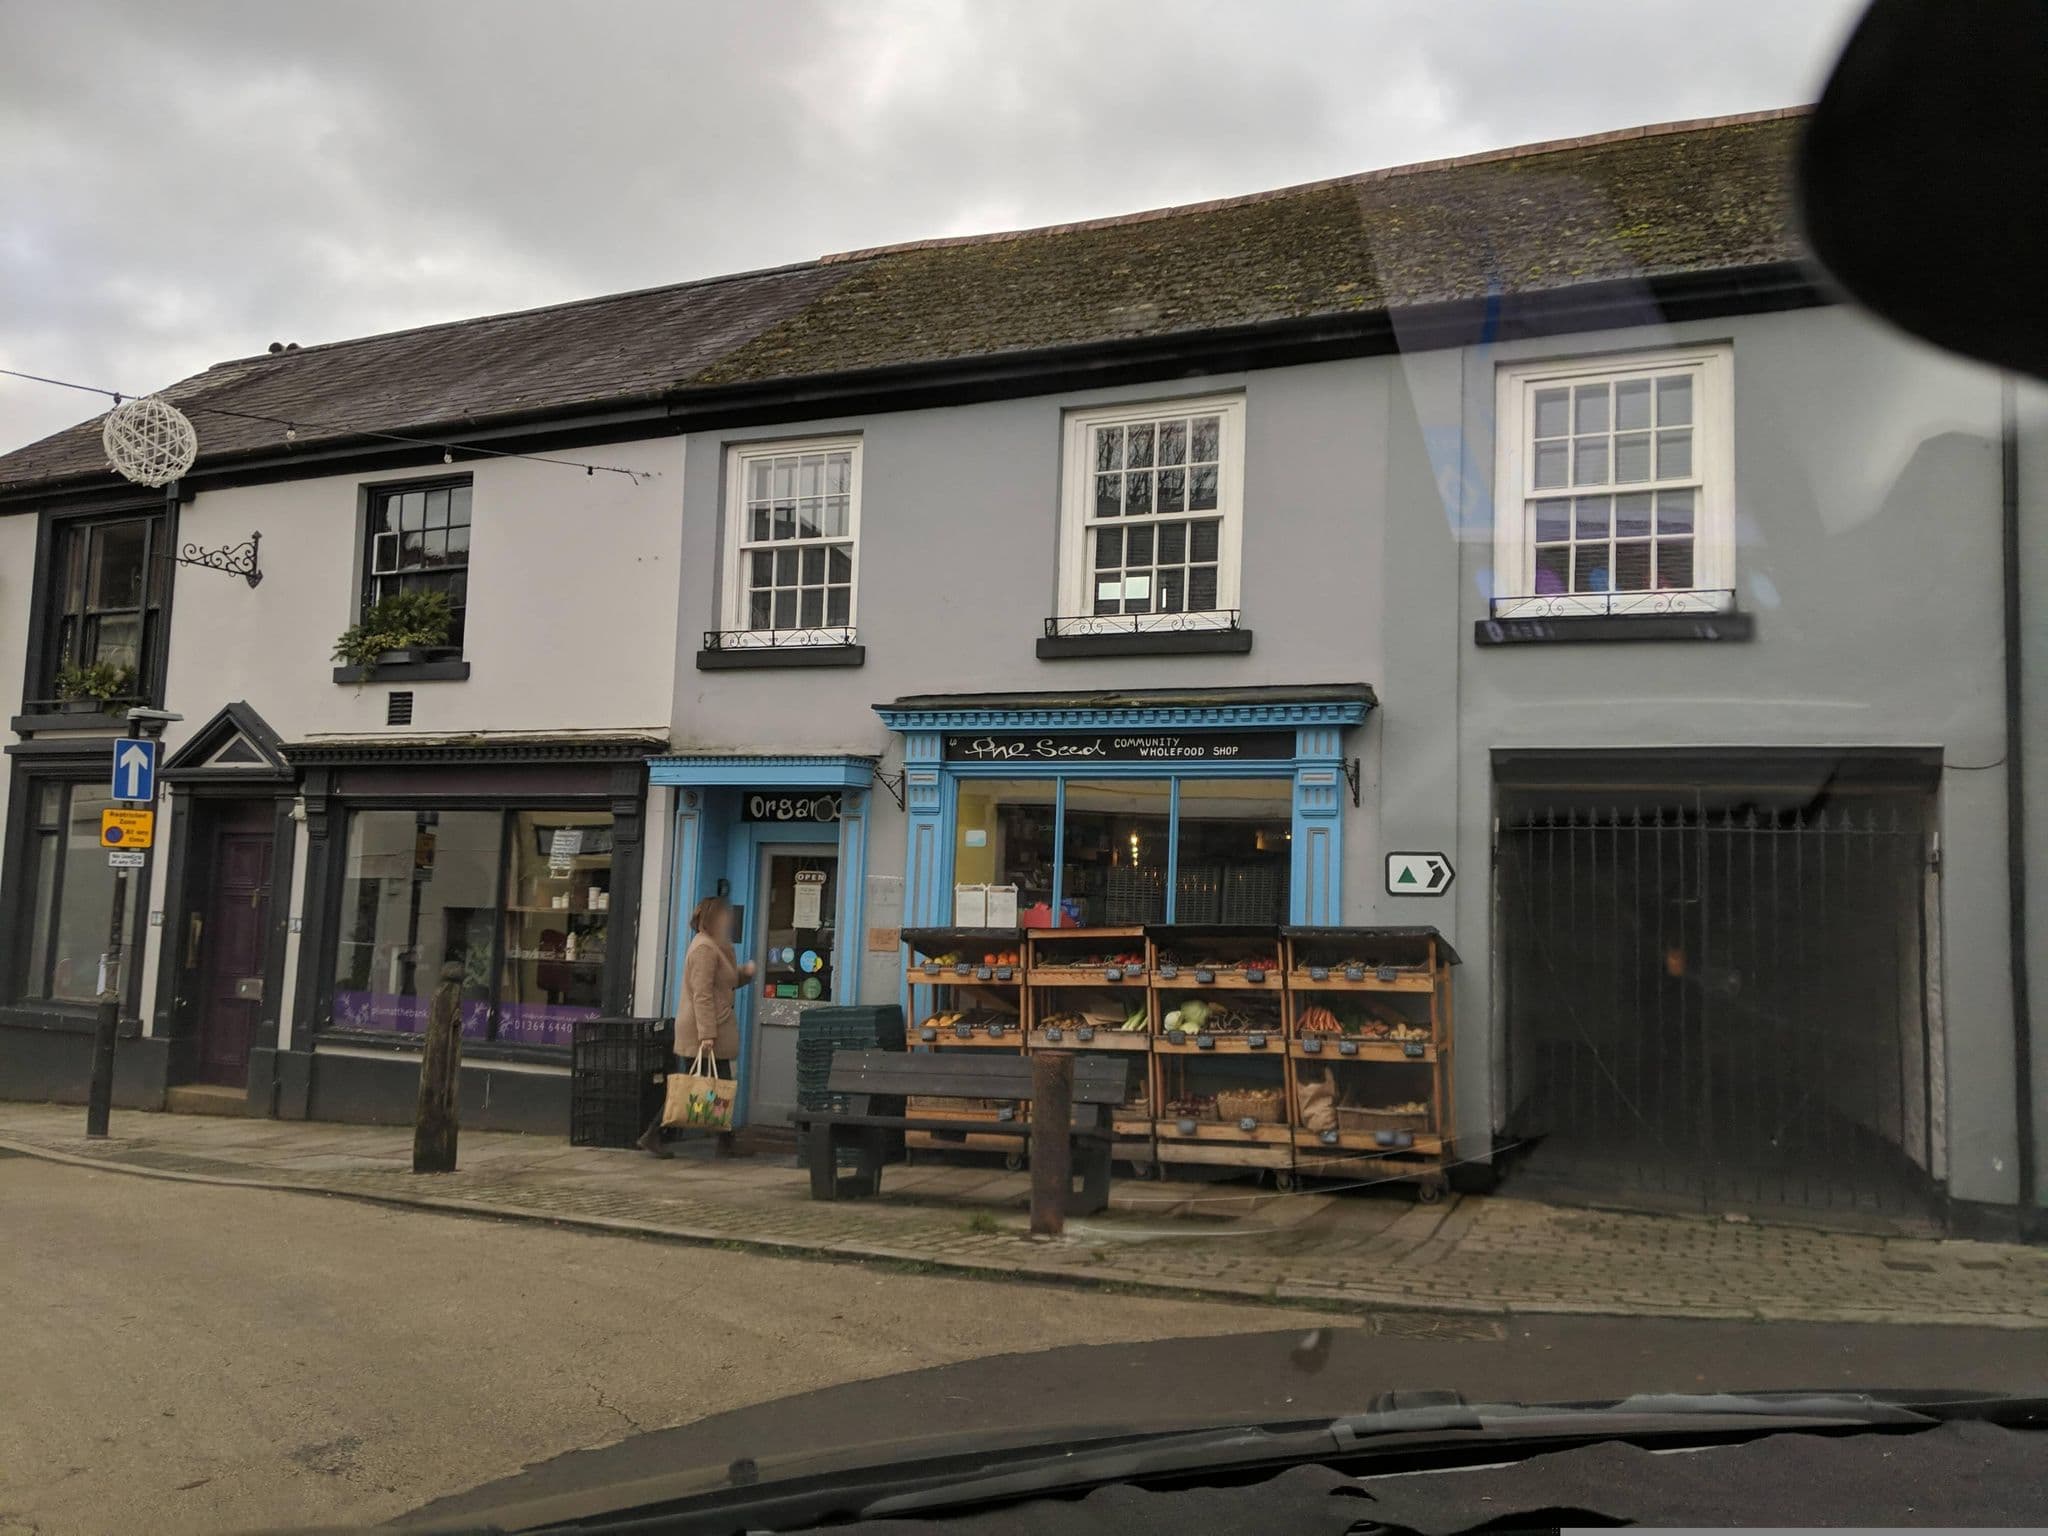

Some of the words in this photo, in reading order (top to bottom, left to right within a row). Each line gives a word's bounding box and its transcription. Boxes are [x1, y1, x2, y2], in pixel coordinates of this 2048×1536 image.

[1032, 738, 1106, 757] Seed
[1114, 738, 1180, 749] COMMUNITY
[1140, 747, 1205, 757] WHOLEFOOD
[1213, 746, 1239, 756] SHOP
[797, 873, 825, 881] OPEN
[515, 1020, 545, 1032] 01364
